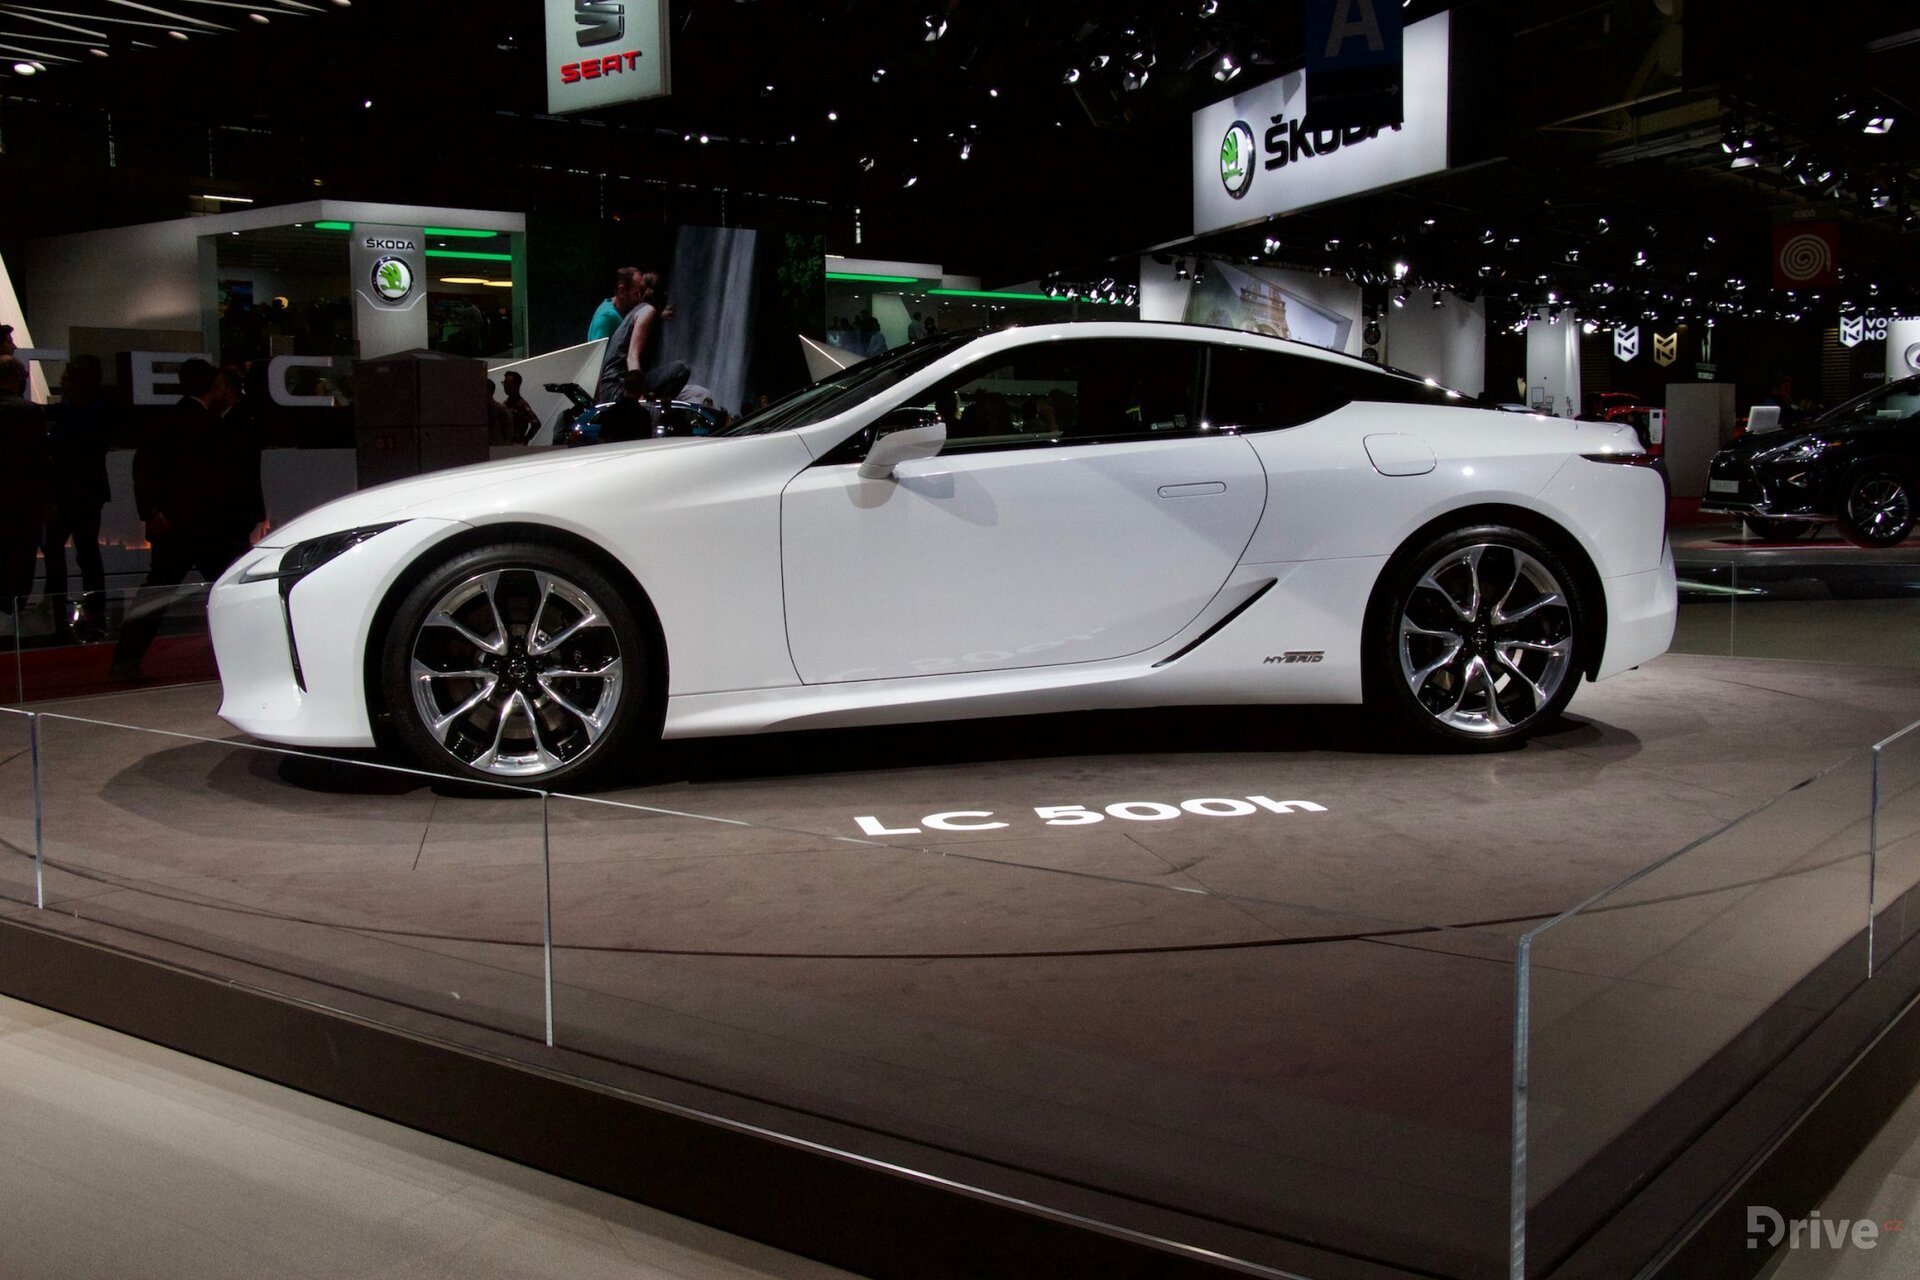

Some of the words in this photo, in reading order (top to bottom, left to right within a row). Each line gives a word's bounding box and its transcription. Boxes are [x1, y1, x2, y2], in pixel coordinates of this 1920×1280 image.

[1324, 0, 1385, 58] A
[560, 50, 643, 84] SEAT
[1265, 114, 1402, 171] ŠKOD
[366, 237, 416, 250] ŠKODA
[1263, 653, 1325, 664] HYBRID
[854, 811, 1010, 836] LC
[1034, 796, 1328, 826] 500h
